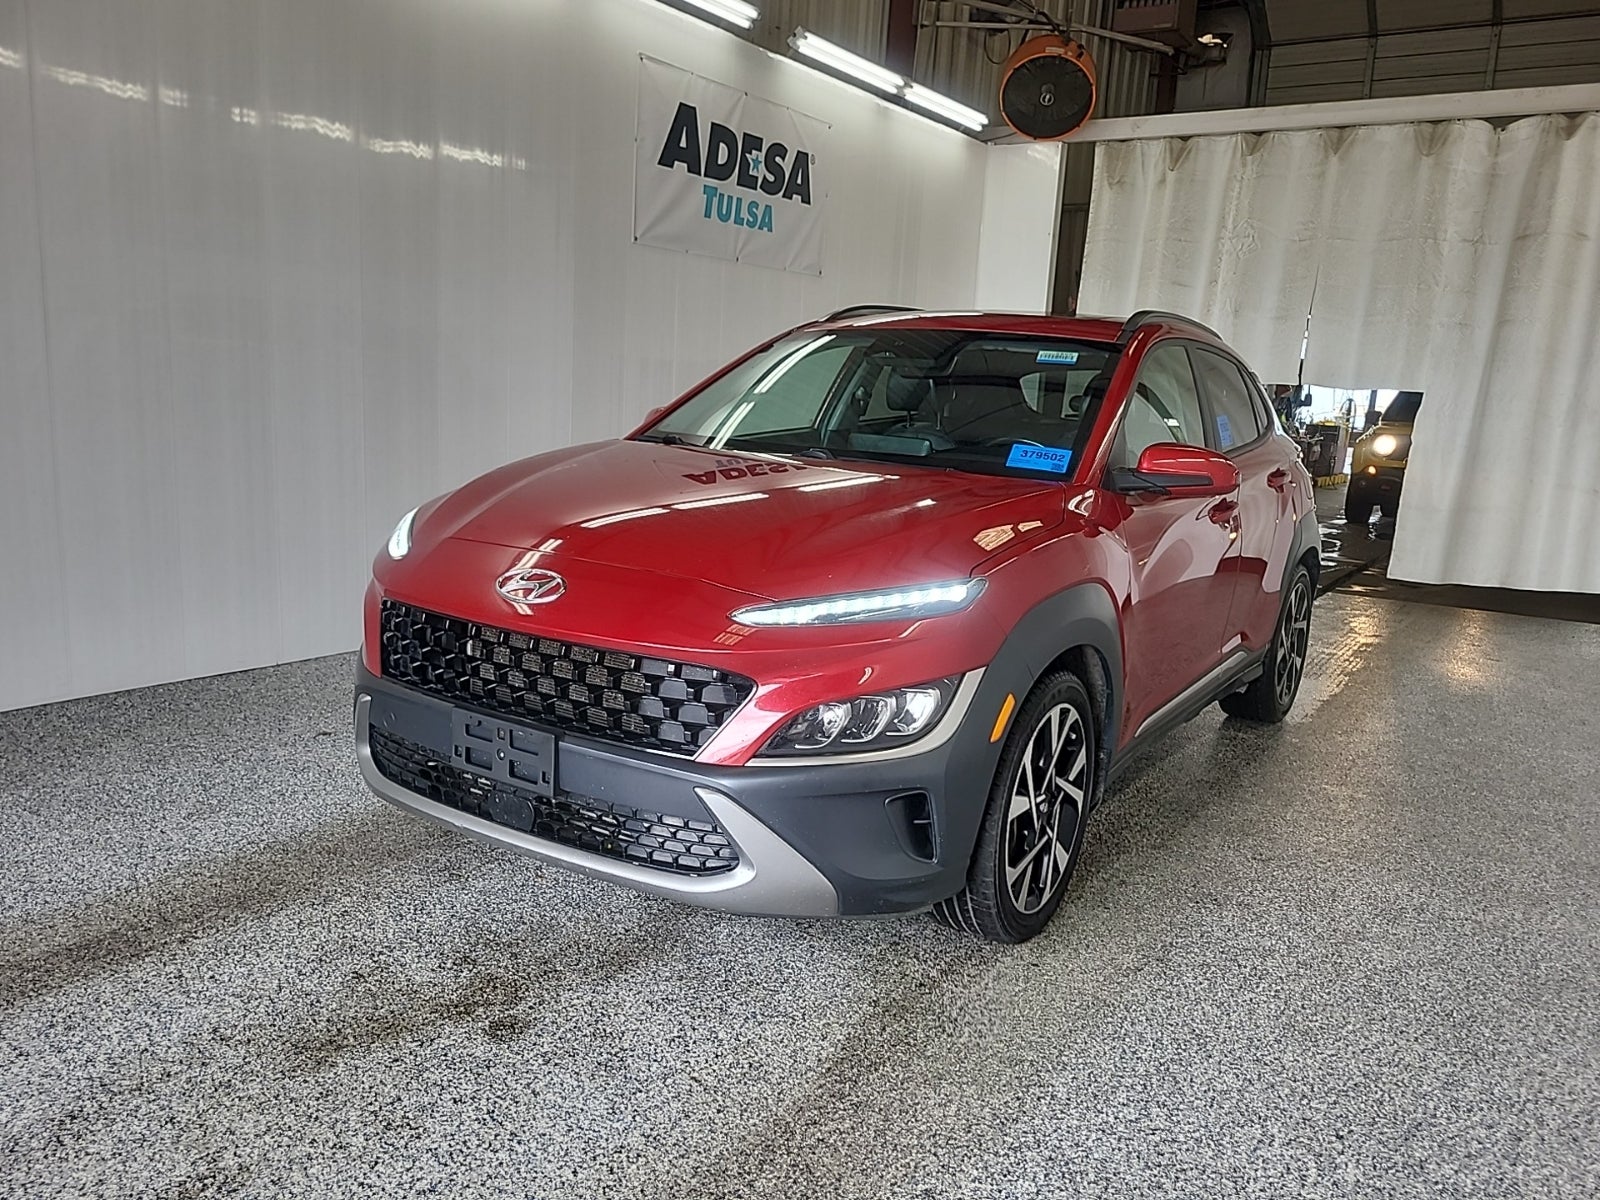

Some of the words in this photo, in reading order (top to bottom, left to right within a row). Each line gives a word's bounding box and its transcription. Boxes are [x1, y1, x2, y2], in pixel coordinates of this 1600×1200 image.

[657, 101, 811, 206] ADESA
[703, 184, 773, 233] TULSA
[1020, 449, 1066, 463] 379502
